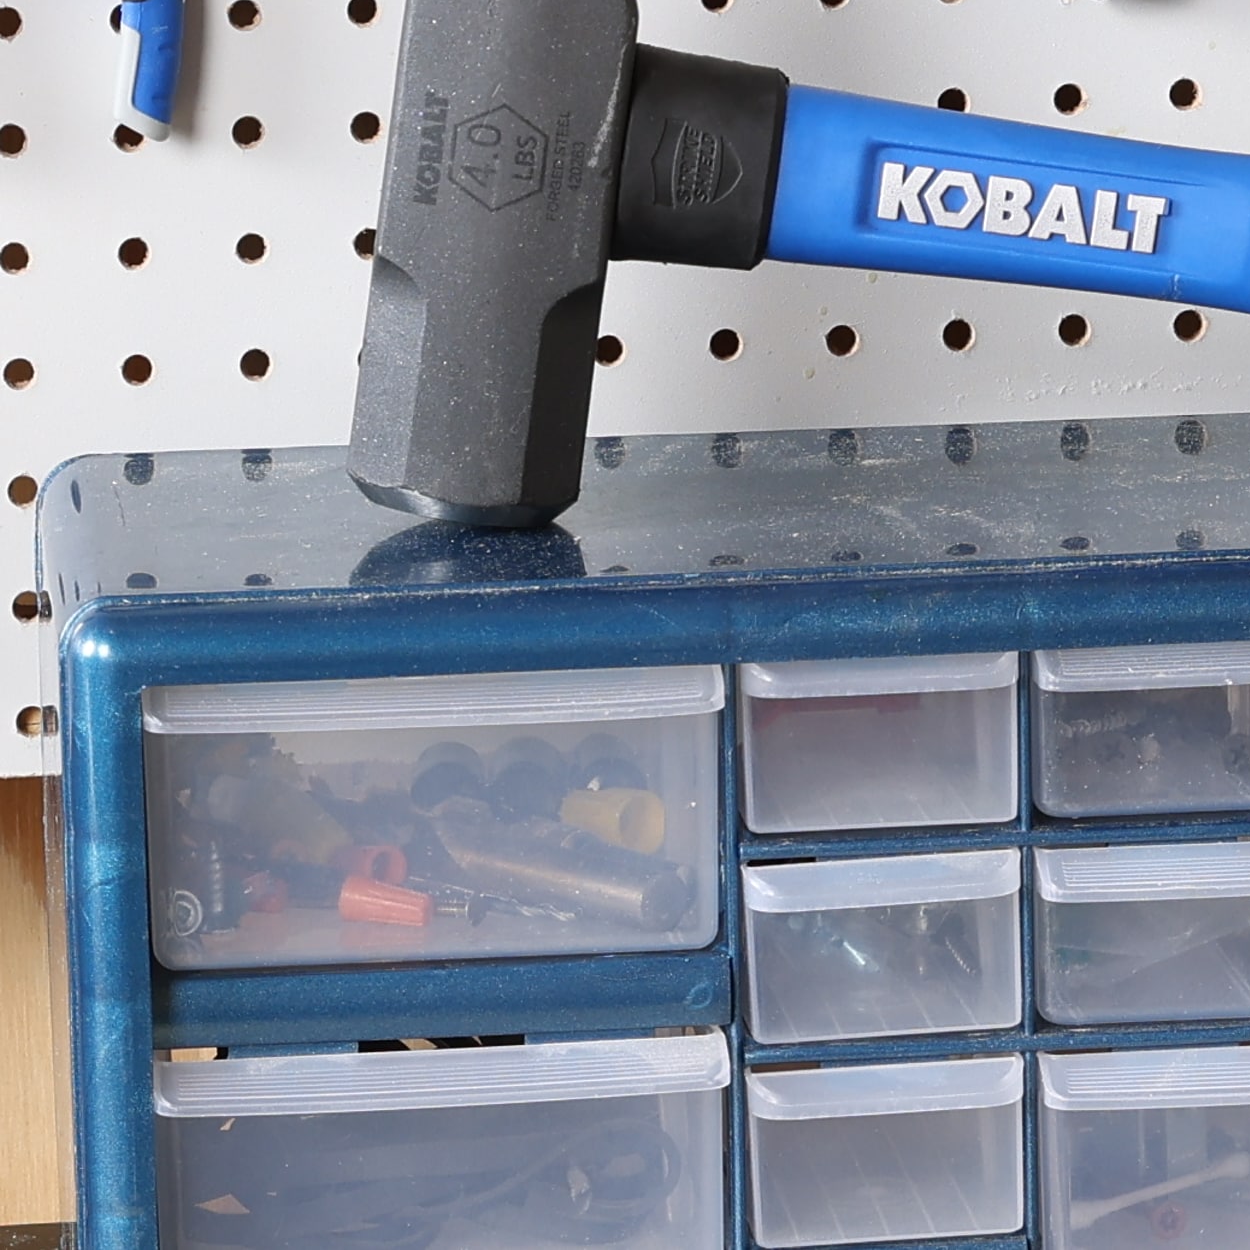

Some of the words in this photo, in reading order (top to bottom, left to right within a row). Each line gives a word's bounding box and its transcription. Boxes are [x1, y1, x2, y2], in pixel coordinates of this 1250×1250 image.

[412, 89, 449, 206] KOBALT
[460, 123, 502, 188] 4.0
[511, 134, 538, 182] LBS
[553, 111, 571, 156] STEEL
[877, 161, 1170, 254] KOBALT
